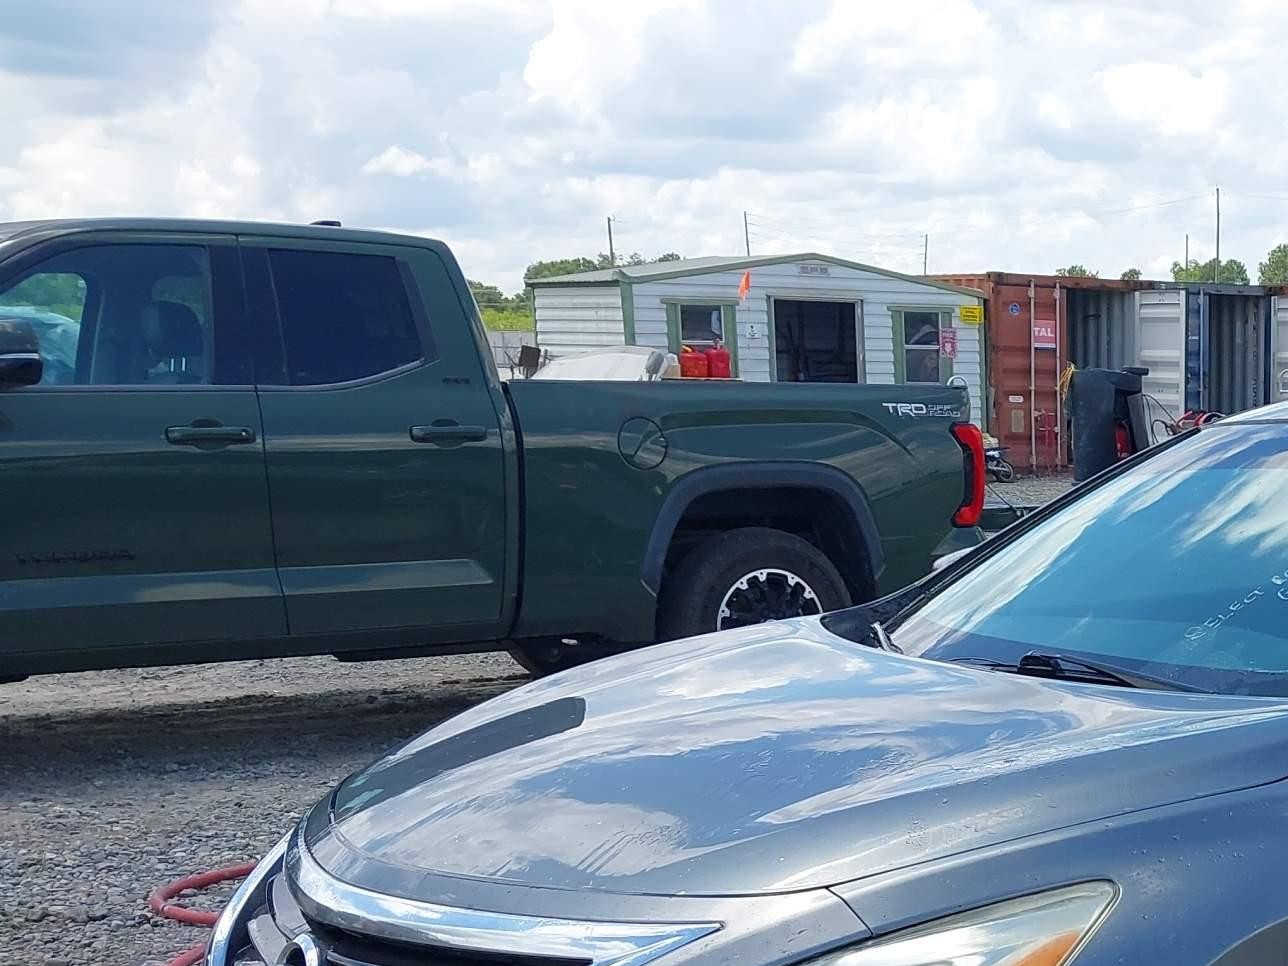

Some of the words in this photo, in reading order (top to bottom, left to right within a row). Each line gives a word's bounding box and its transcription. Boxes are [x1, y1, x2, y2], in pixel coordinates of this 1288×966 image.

[1033, 327, 1055, 337] TAL
[882, 403, 927, 417] TRD
[1184, 585, 1264, 641] SELECT
